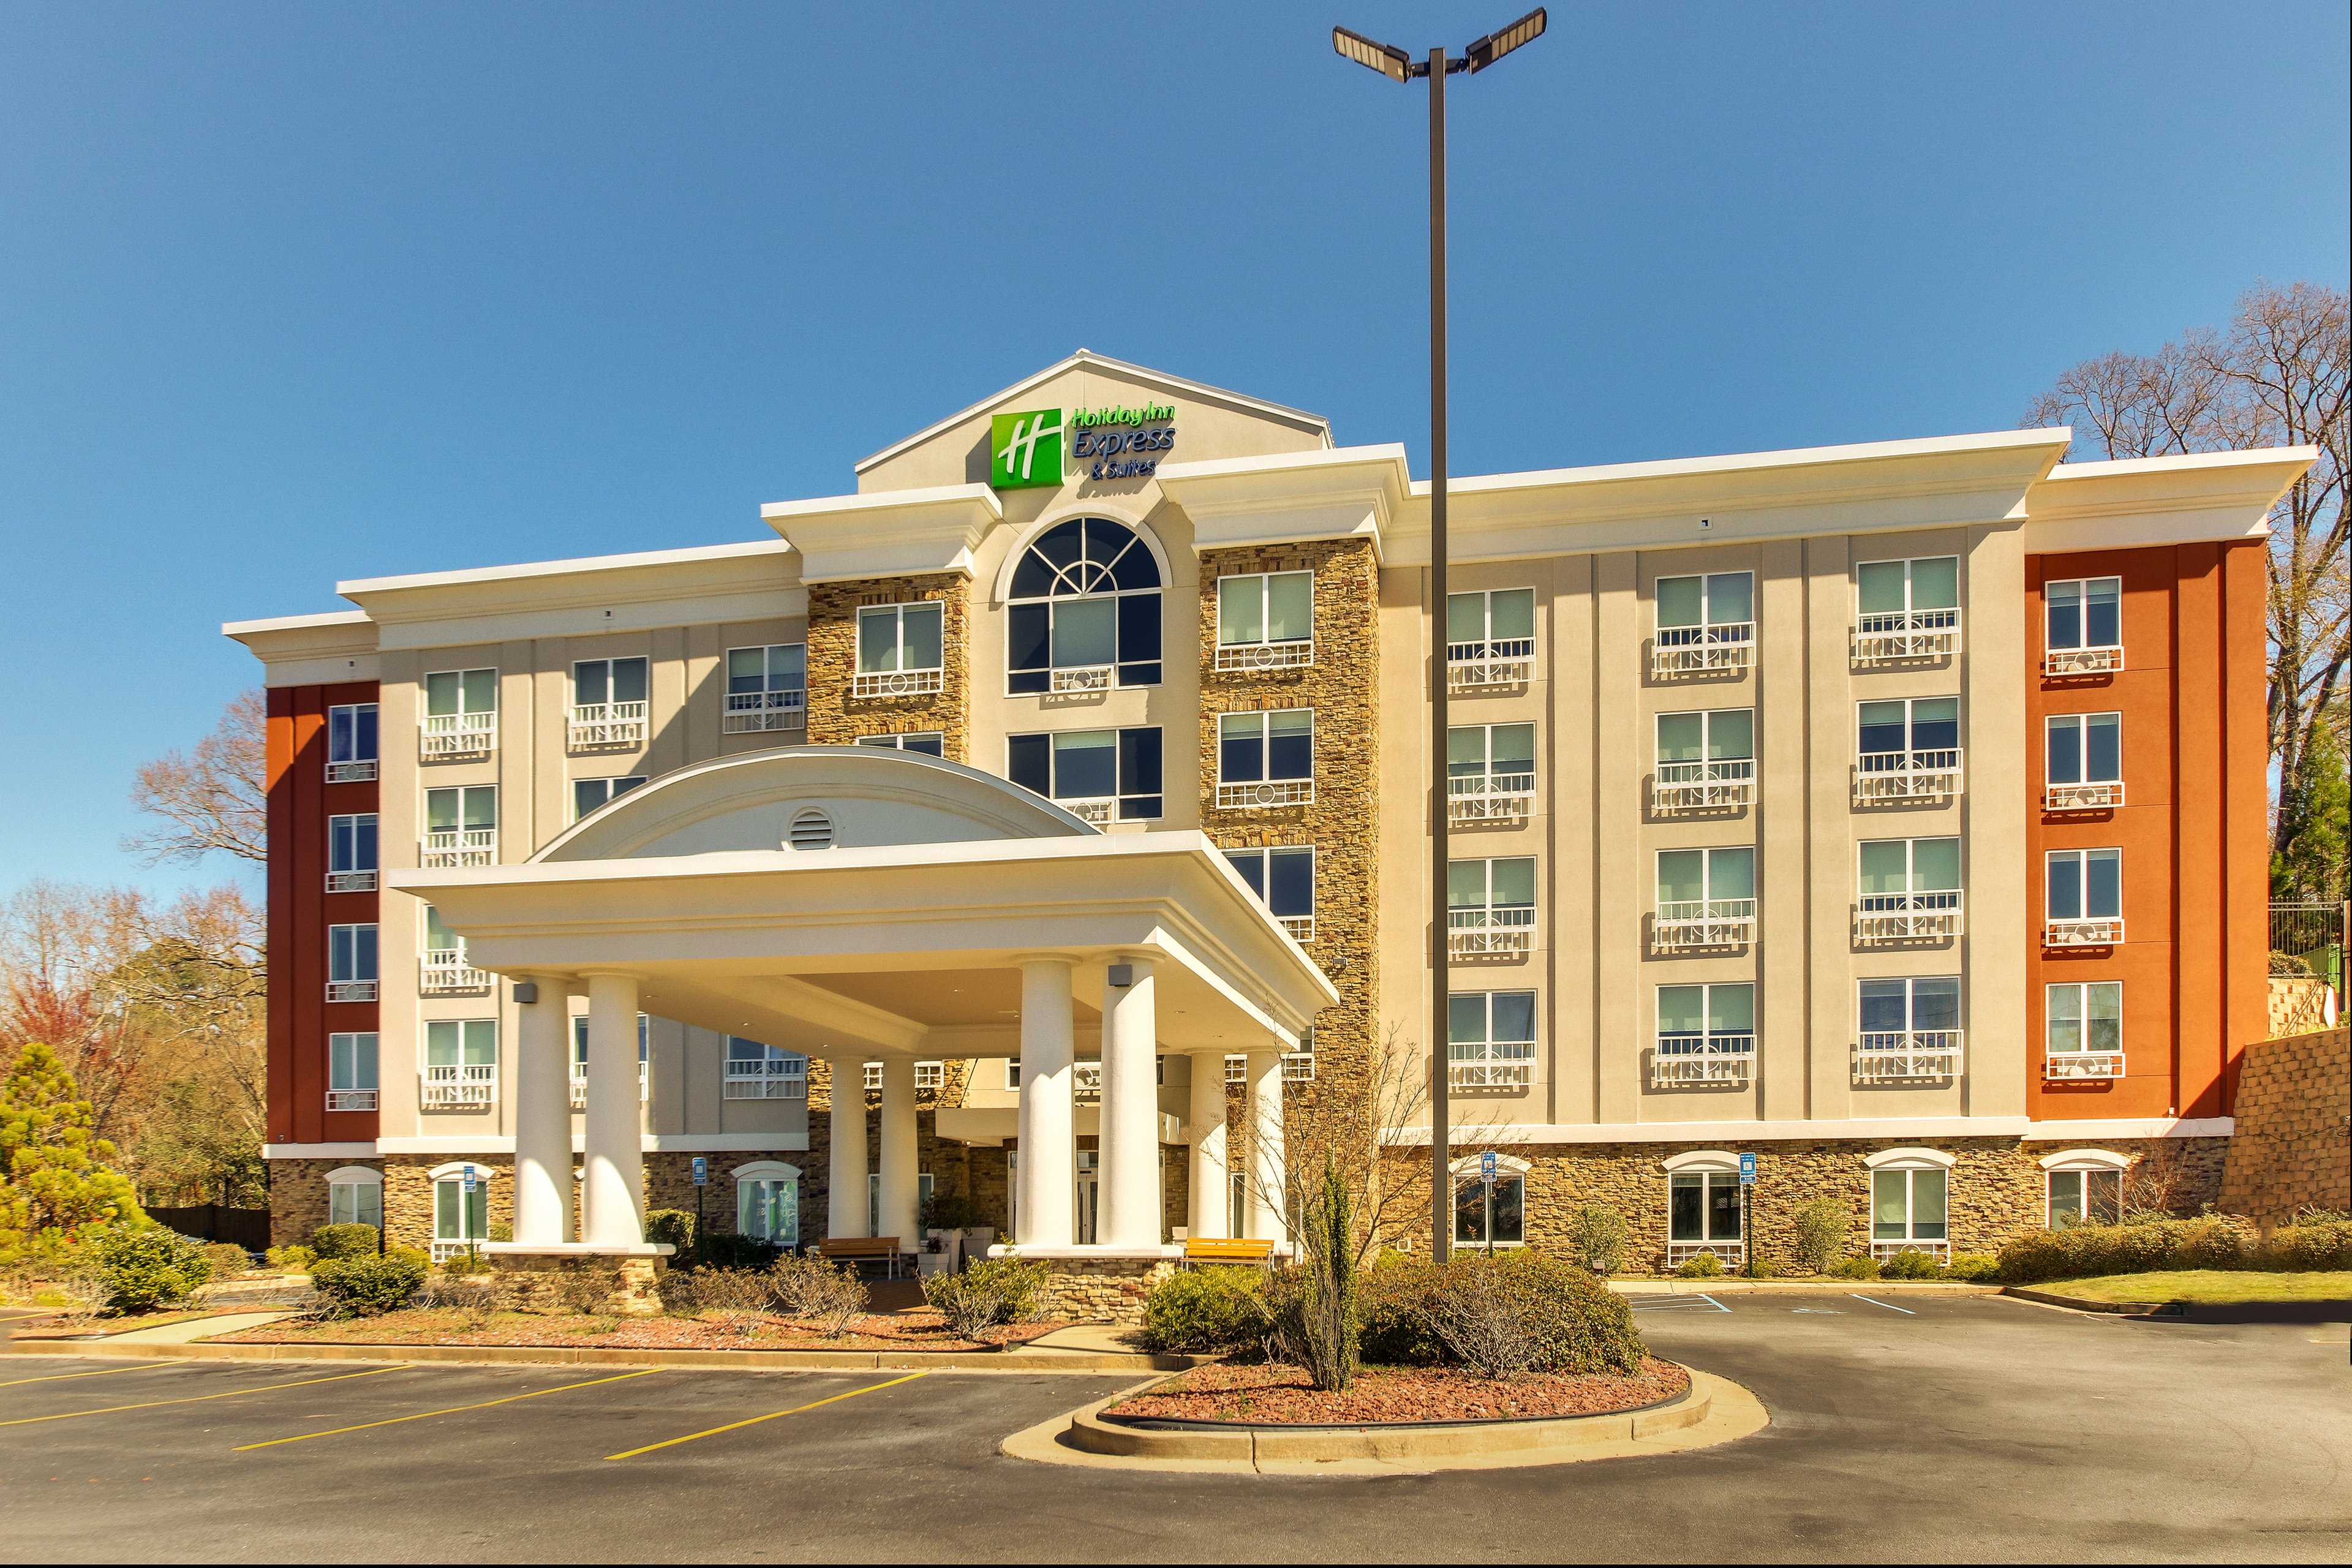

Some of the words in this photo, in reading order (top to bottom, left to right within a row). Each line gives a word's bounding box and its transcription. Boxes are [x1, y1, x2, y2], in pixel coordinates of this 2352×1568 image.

[1071, 405, 1143, 428] Holiday
[1146, 401, 1175, 421] Inn
[998, 413, 1061, 480] H
[1073, 428, 1176, 461] Express
[1091, 462, 1103, 481] &
[1106, 460, 1156, 479] Suites
